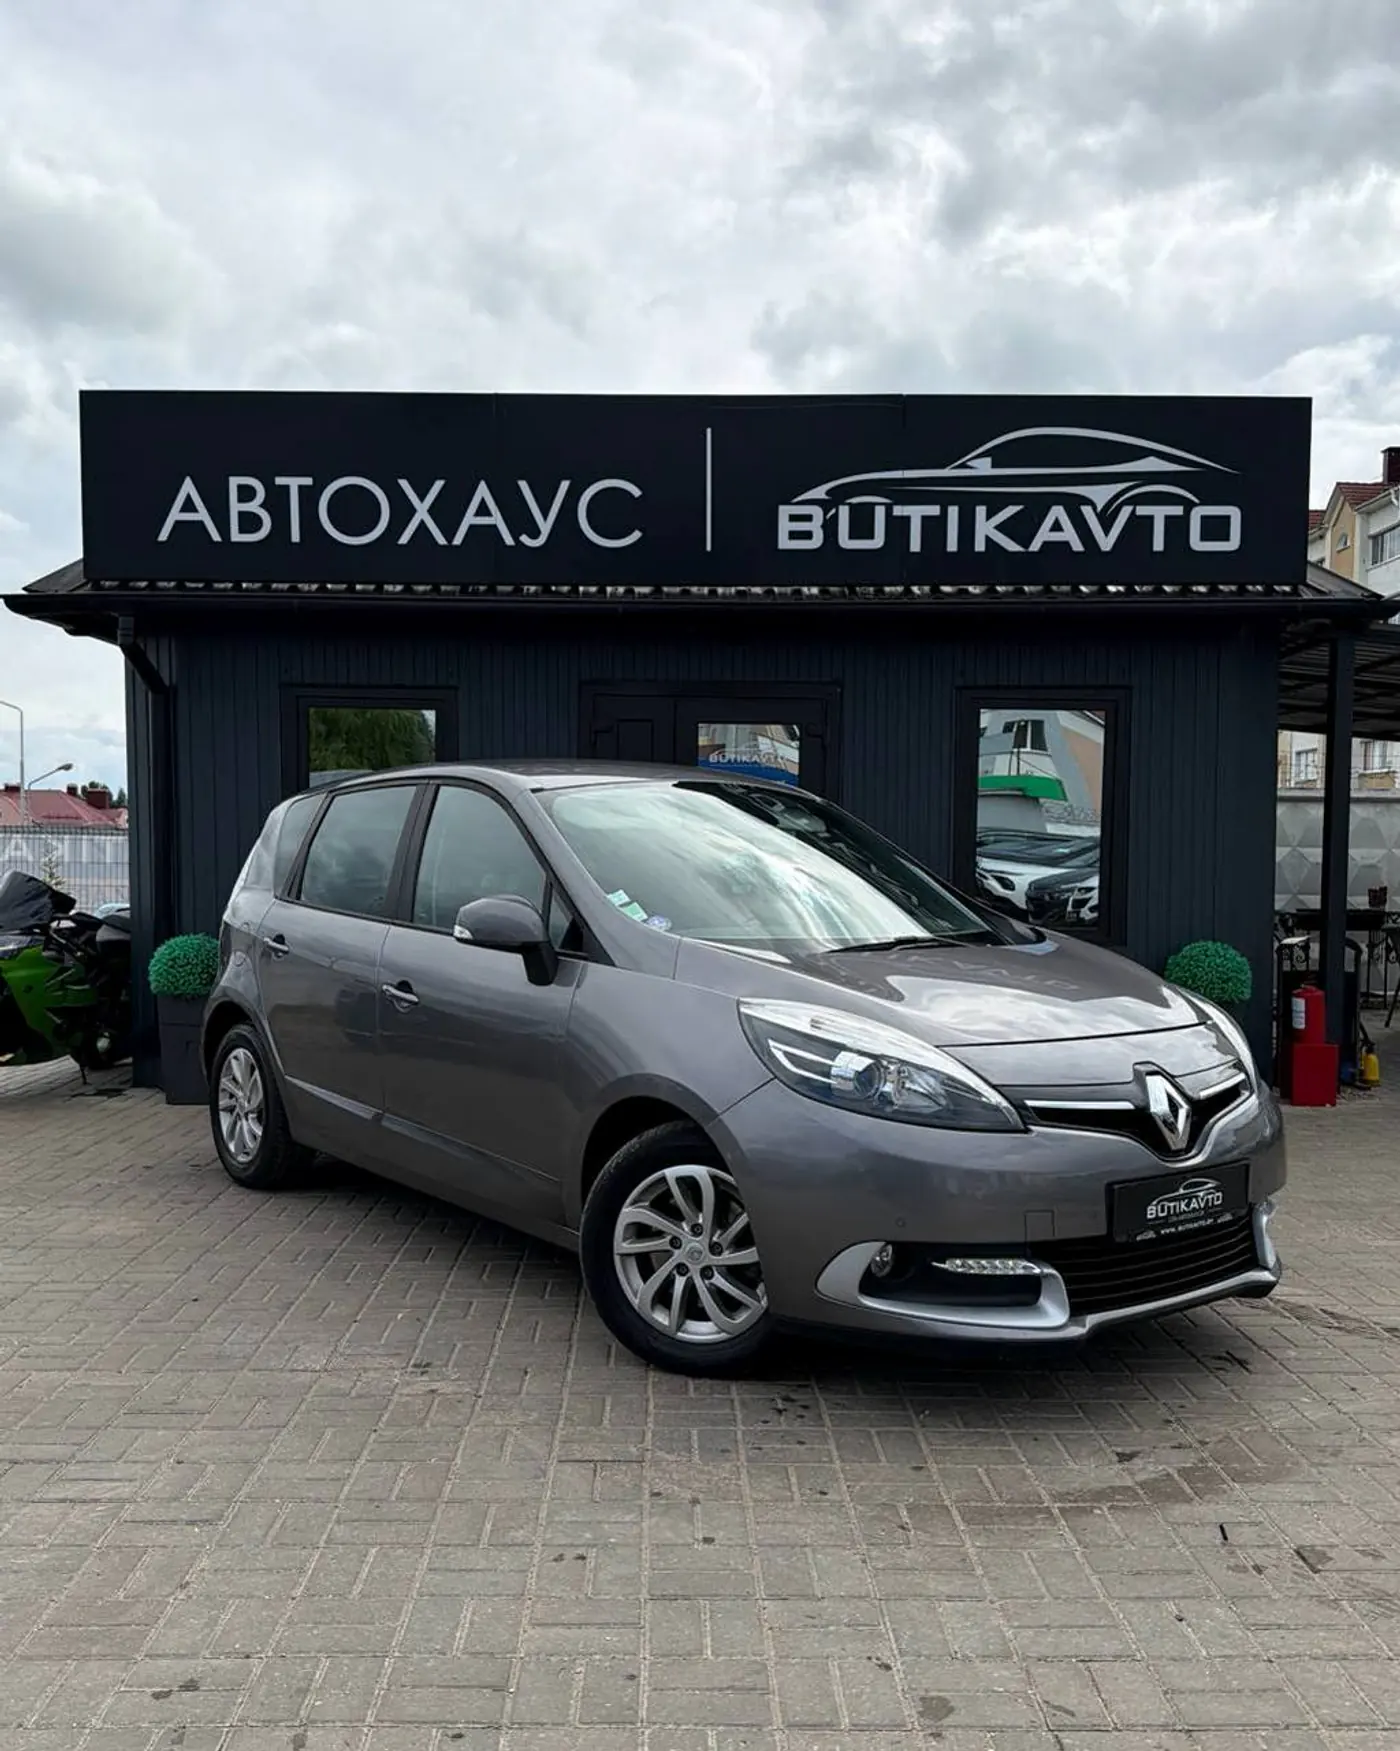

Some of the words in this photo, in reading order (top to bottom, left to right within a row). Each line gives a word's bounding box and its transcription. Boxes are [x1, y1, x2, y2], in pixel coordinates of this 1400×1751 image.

[157, 475, 643, 548] АВТОХАУС
[777, 504, 1242, 553] BUTIKAVTO
[1146, 1192, 1223, 1219] BUTIKAVTO
